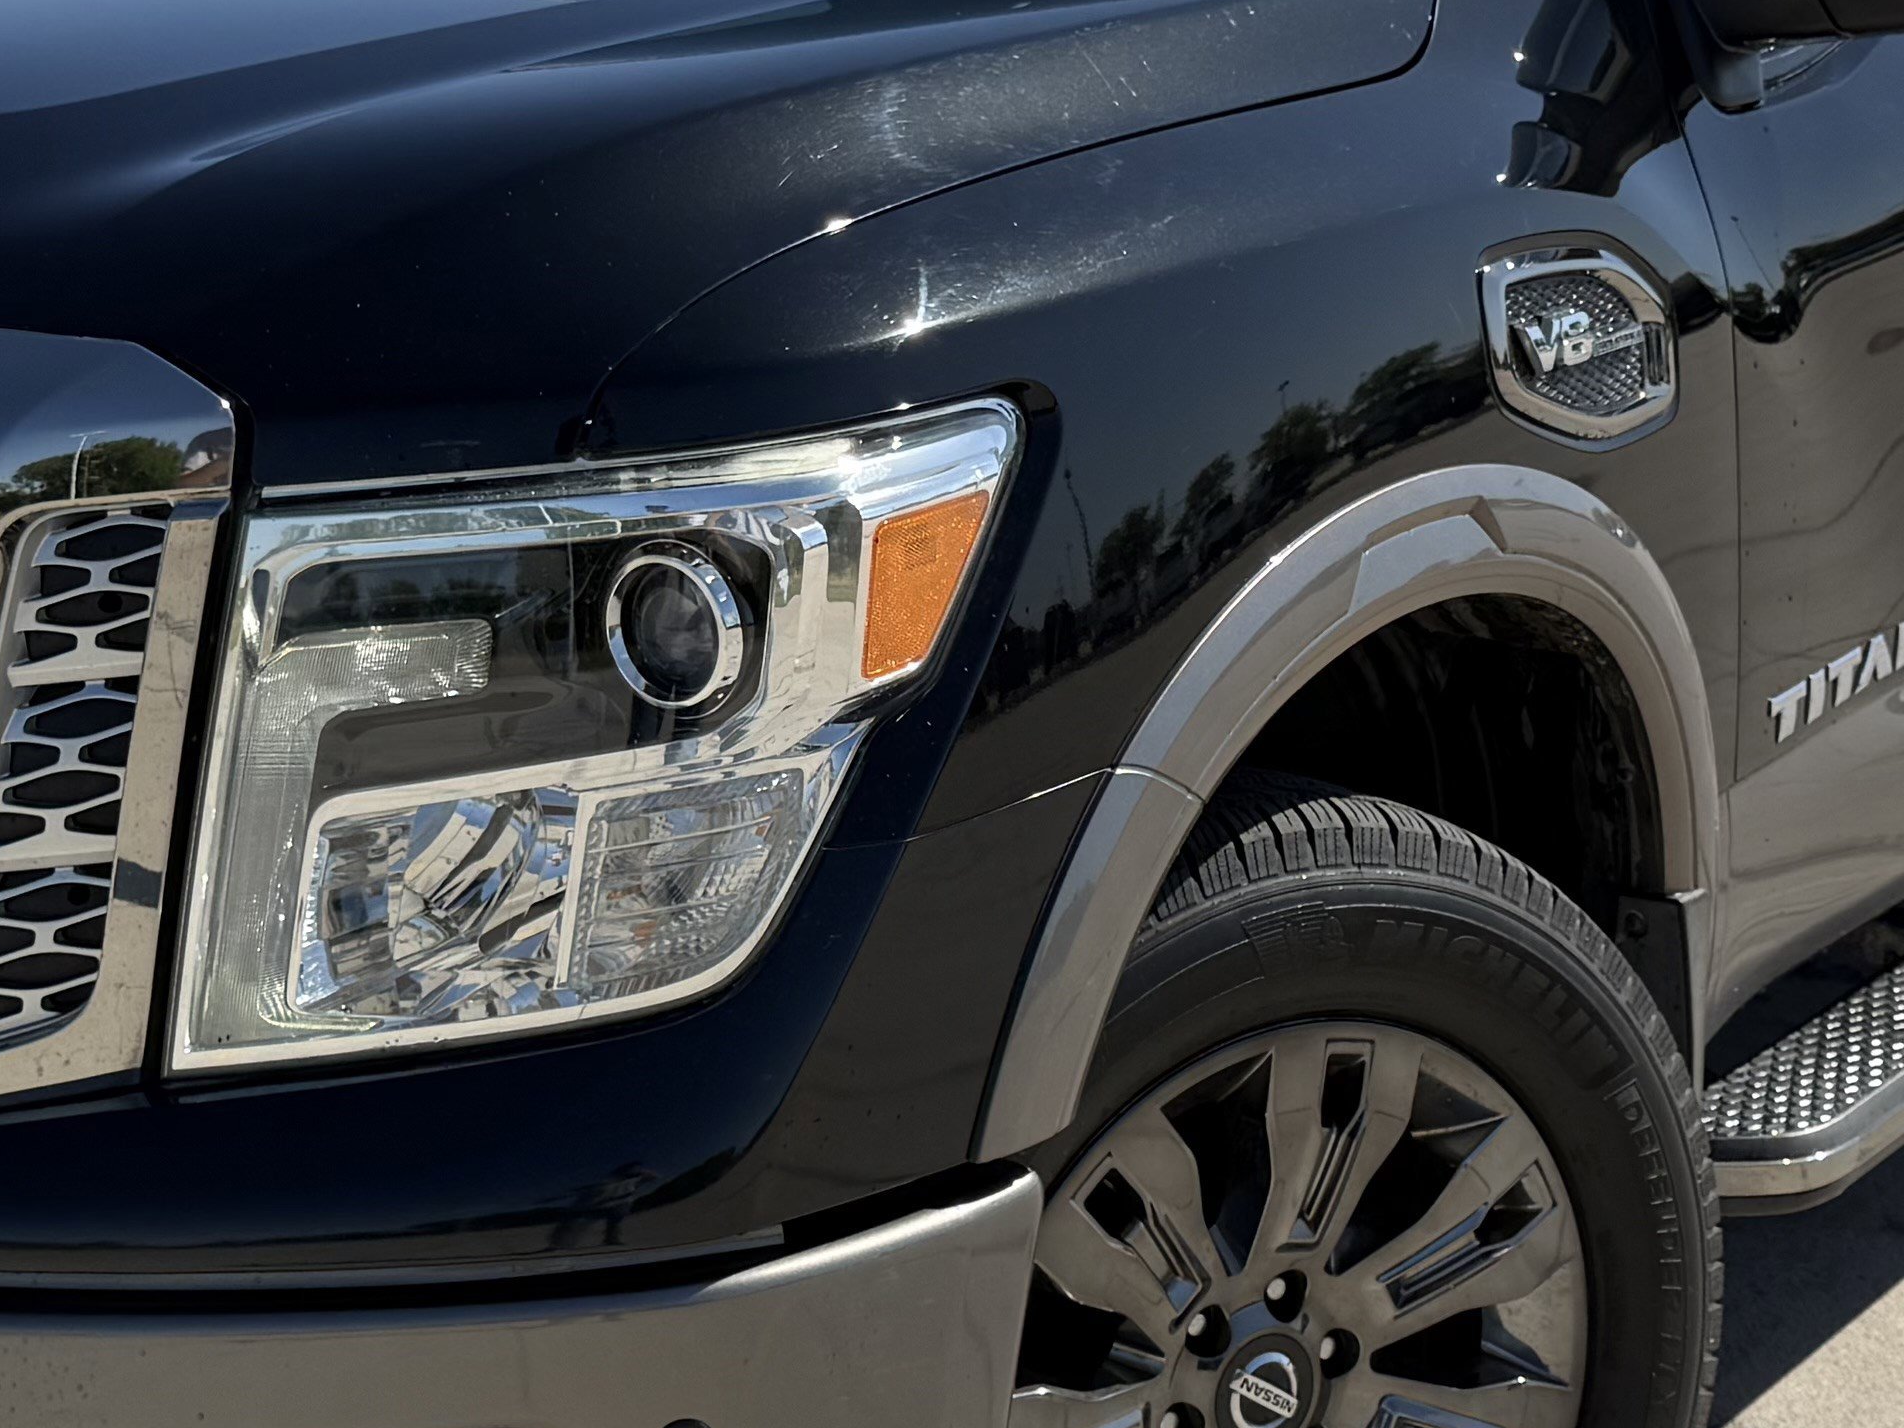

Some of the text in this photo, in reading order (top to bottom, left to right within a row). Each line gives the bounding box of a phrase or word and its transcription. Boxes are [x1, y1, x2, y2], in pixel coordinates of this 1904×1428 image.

[1524, 310, 1595, 372] V8
[1366, 917, 1623, 1080] MICHELIN
[1240, 1377, 1295, 1413] NISSAN
